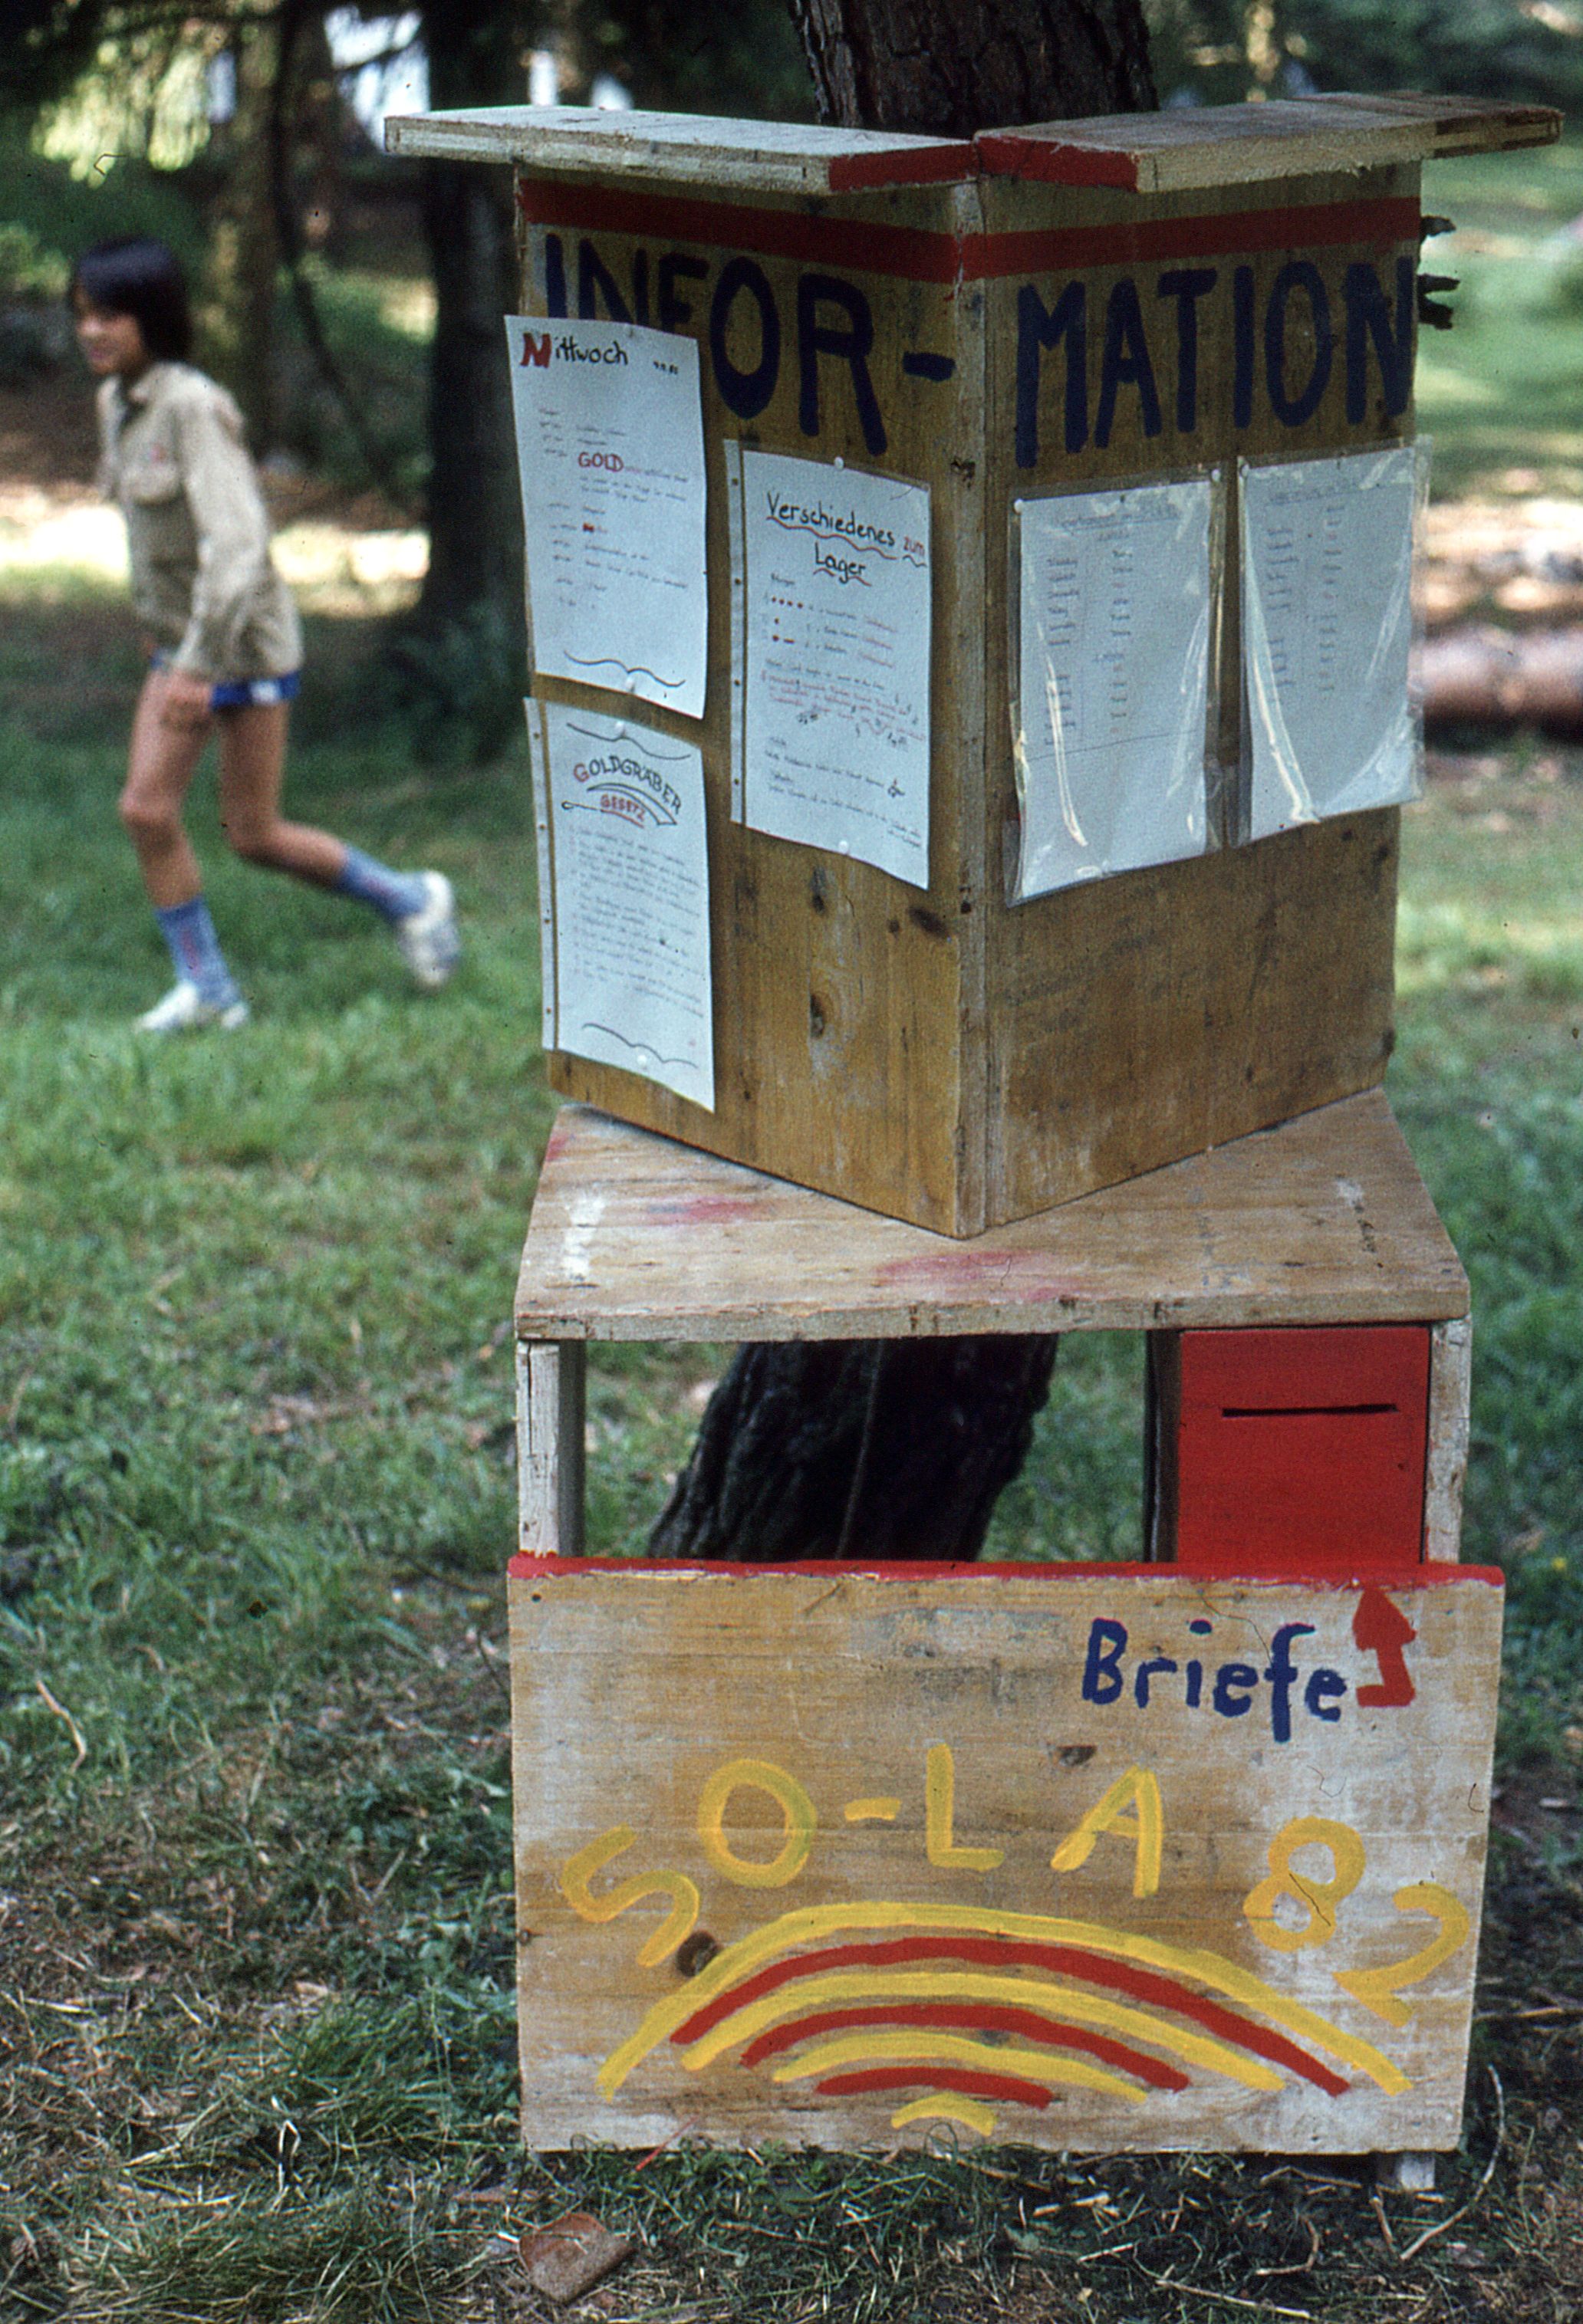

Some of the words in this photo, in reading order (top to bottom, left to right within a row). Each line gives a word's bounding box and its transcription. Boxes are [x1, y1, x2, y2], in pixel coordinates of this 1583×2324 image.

[519, 331, 628, 369] Mittwoch
[1015, 256, 1414, 468] MATION
[578, 452, 624, 472] GOLD
[767, 491, 895, 546] Verschiedenes
[815, 541, 867, 584] Lager
[1081, 1617, 1348, 1743] Briefe
